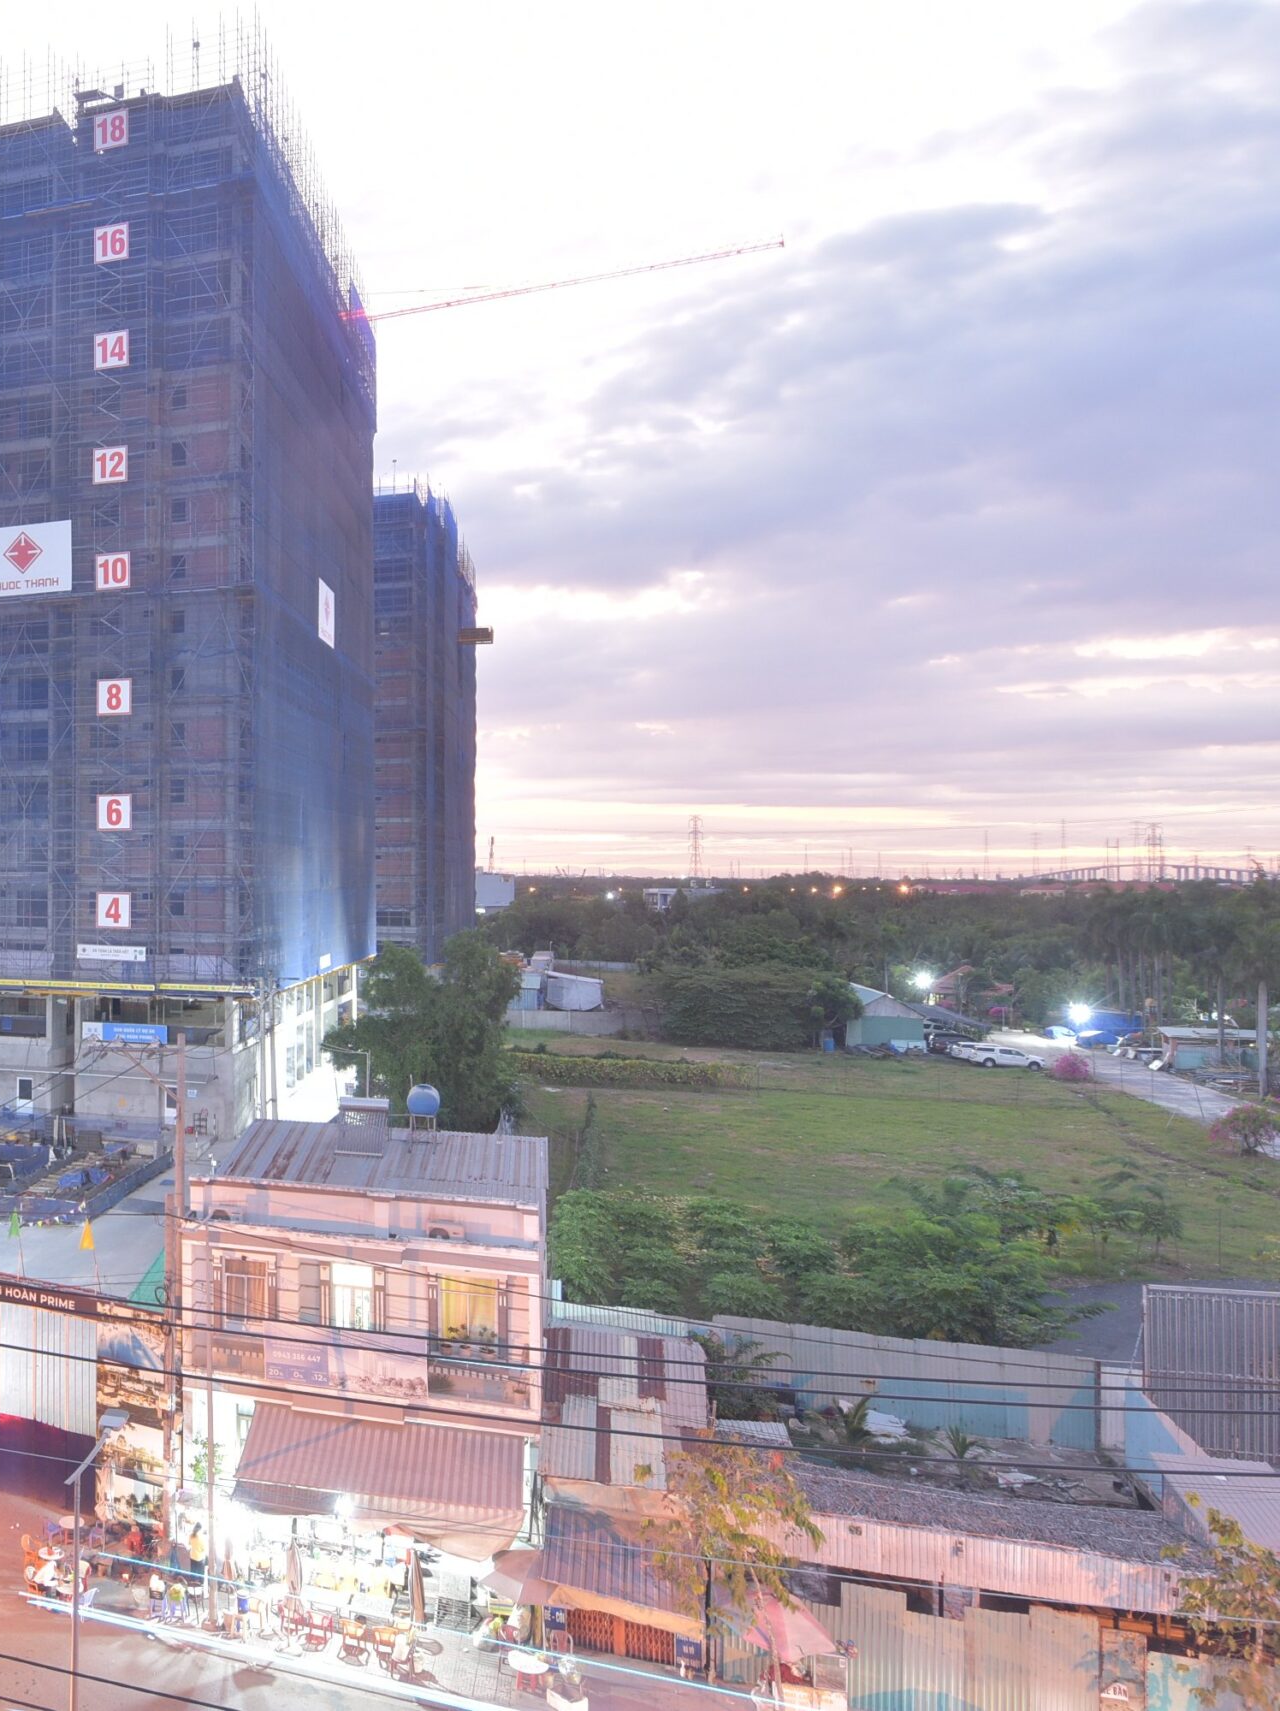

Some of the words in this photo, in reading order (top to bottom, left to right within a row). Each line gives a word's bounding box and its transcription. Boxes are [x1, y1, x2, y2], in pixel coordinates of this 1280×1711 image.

[96, 114, 125, 145] 18
[96, 228, 126, 257] 16
[96, 335, 126, 364] 14
[96, 451, 124, 479] 12
[25, 577, 60, 589] THANH
[98, 557, 127, 585] 10
[106, 683, 121, 711] 8
[106, 799, 122, 826] 6
[105, 897, 121, 924] 4
[40, 1294, 76, 1311] PRIME
